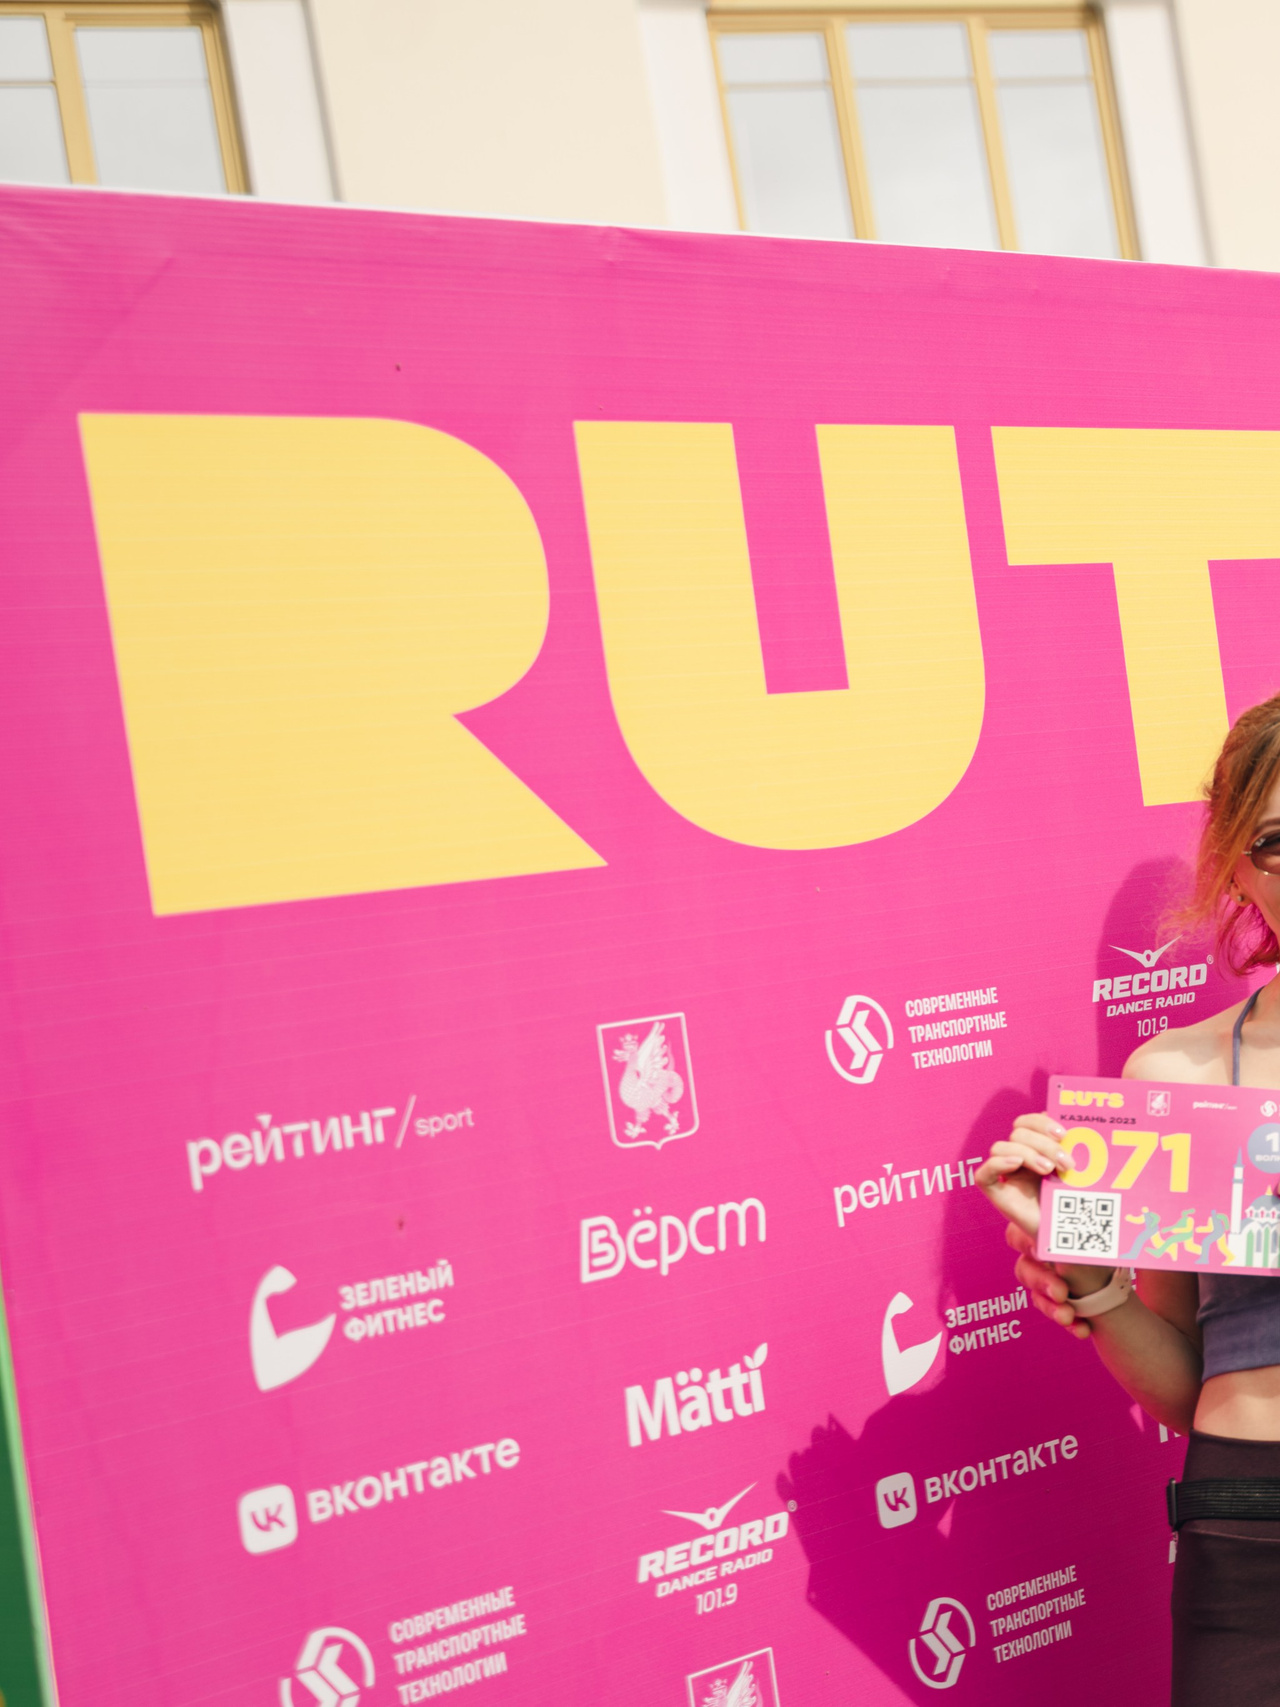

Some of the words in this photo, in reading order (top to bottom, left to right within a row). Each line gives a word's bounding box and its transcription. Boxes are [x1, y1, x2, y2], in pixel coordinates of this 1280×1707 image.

[905, 986, 999, 1018] СОВРЕМЕННЫЕ
[1106, 997, 1153, 1017] DANCE
[1155, 991, 1196, 1010] RADIO
[908, 1011, 1008, 1043] ТРАНСПОРТНЫЕ
[1136, 1015, 1168, 1037] 101.9
[912, 1039, 993, 1070] ТЕХНОЛОГИИ
[1059, 1090, 1125, 1108] RUTS
[1060, 1114, 1107, 1124] КАЗАНЬ
[1109, 1116, 1137, 1125] 2023
[1055, 1126, 1192, 1193] 071
[1265, 1131, 1280, 1153] 1
[338, 1259, 455, 1311] ЗЕЛЕНЫЙ
[342, 1297, 446, 1341] ФИТНЕС
[945, 1286, 1029, 1329] ЗЕЛЕНЫЙ
[948, 1319, 1023, 1355] ФИТНЕС
[625, 1343, 768, 1447] Mätti
[656, 1567, 717, 1598] DANCE
[719, 1548, 774, 1578] RADIO
[986, 1565, 1078, 1611] СОВРЕМЕННЫЕ
[389, 1585, 517, 1644] СОВРЕМЕННЫЕ
[695, 1582, 739, 1616] 101.9
[989, 1588, 1087, 1638] ТРАНСПОРТНЫЕ
[393, 1612, 528, 1675] ТРАНСПОРТНЫЕ
[993, 1619, 1073, 1664] ТЕХНОЛОГИИ
[398, 1651, 508, 1706] ТЕХНОЛОГИИ
